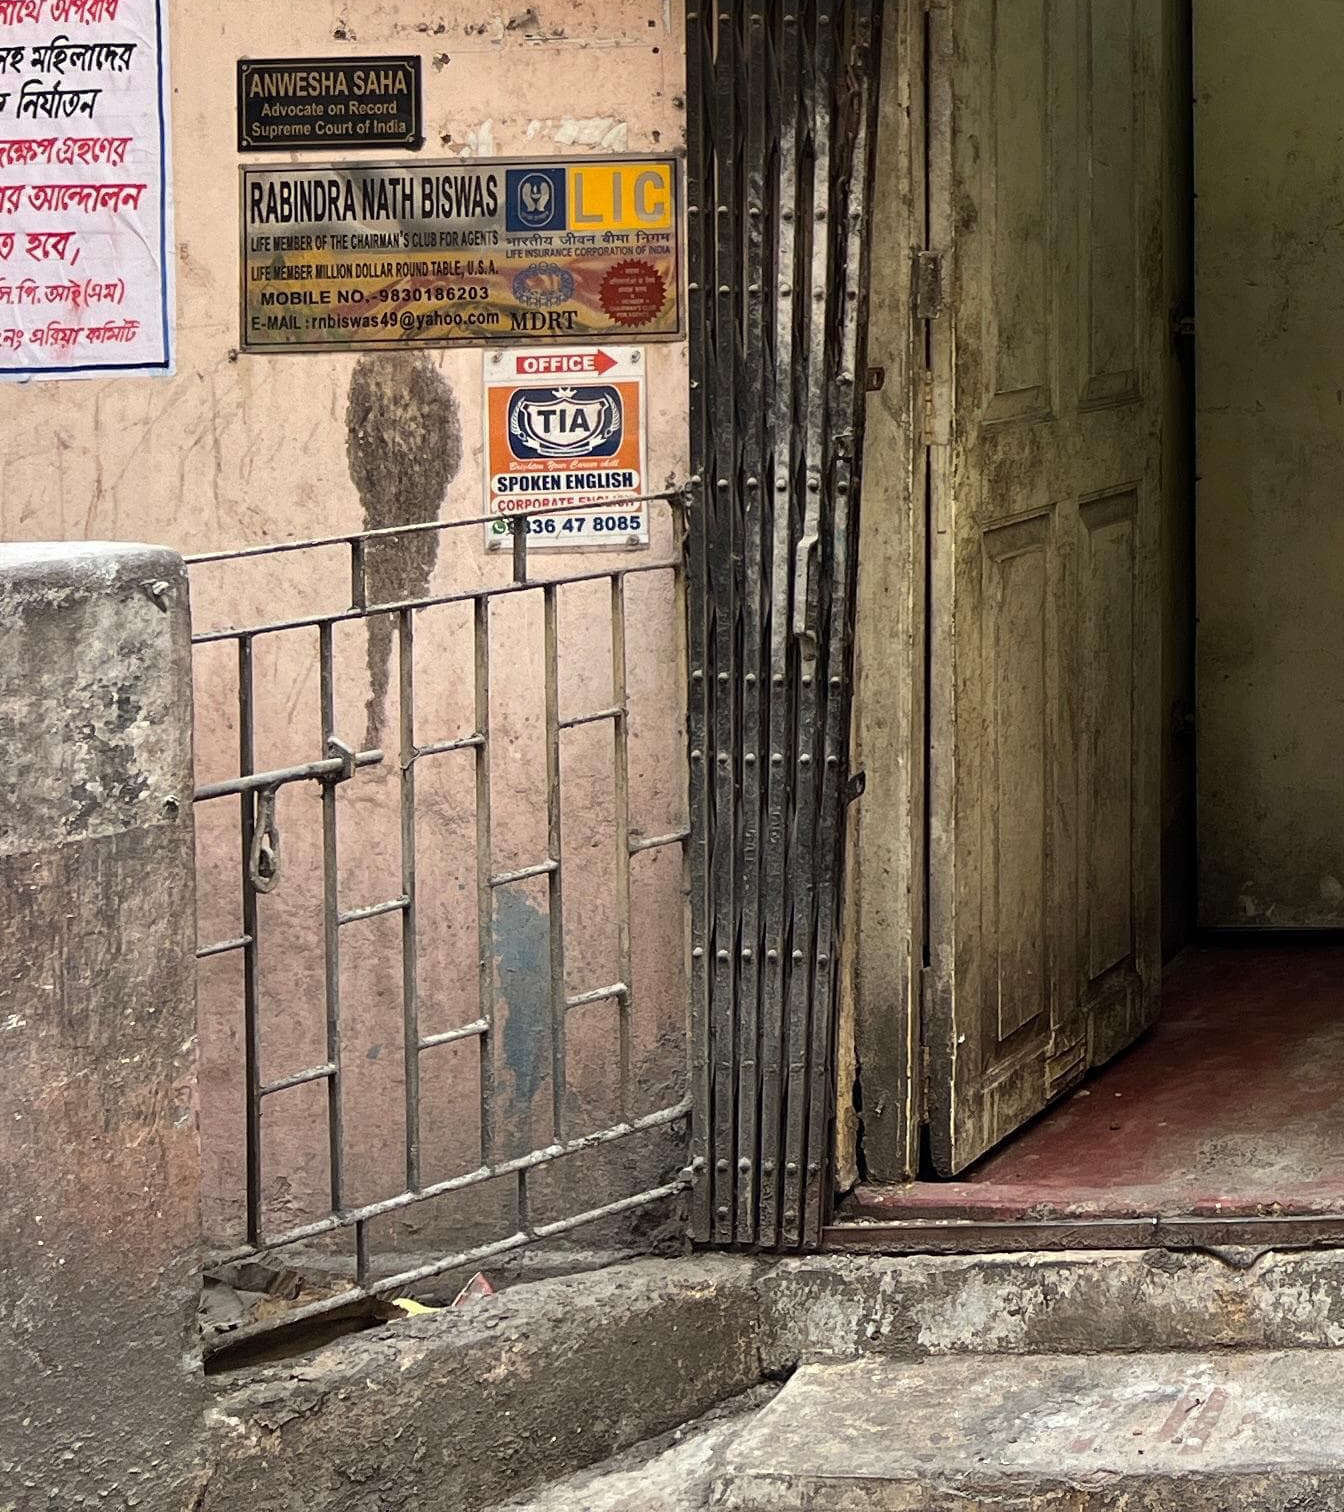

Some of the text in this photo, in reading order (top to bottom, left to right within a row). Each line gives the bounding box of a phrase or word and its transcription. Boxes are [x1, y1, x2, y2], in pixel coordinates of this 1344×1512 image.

[250, 71, 407, 97] ANWESHA SAHA
[261, 101, 397, 117] Advocate on Record
[251, 174, 498, 224] RABINDRA NATH BISWAS
[574, 169, 665, 223] LIC
[260, 291, 333, 306] MOBILE
[511, 311, 577, 331] MDRT
[524, 356, 595, 373] OFFICE
